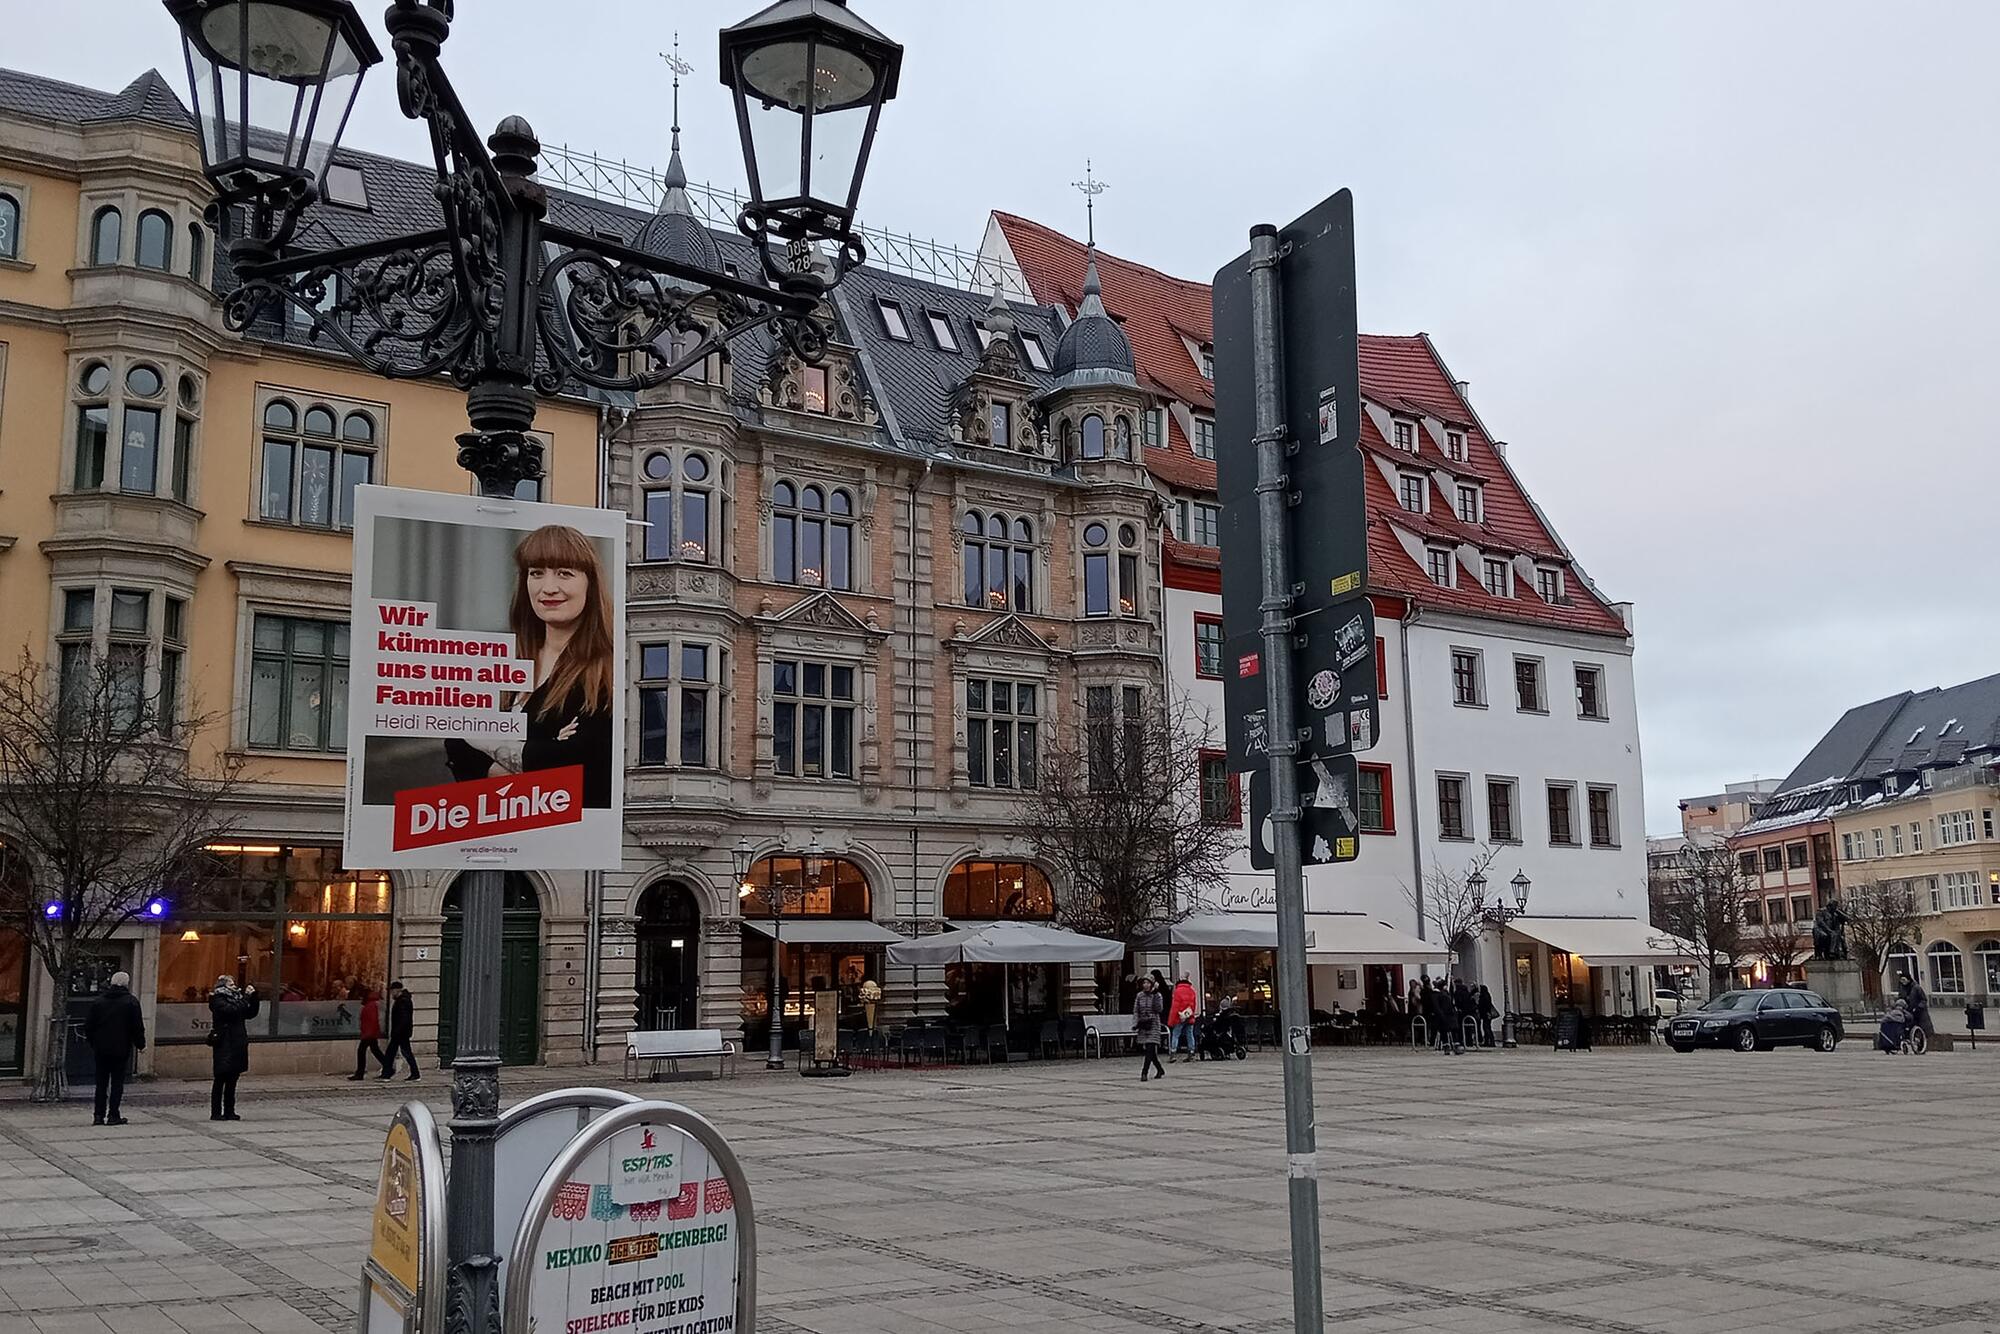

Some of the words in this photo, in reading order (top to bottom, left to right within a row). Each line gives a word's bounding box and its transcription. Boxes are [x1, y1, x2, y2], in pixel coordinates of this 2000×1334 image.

[378, 605, 429, 627] Wir
[378, 631, 508, 657] kümmern
[377, 662, 426, 680] uns
[431, 664, 473, 682] um
[477, 664, 526, 684] alle
[376, 685, 493, 709] Familien
[375, 714, 420, 730] Heidi
[425, 715, 520, 733] Reichinnek
[410, 798, 469, 835] Die
[477, 782, 570, 824] Linke
[622, 1154, 673, 1173] ESPITAS
[546, 1243, 601, 1270] MEXIKO
[658, 1223, 728, 1251] CKENBERG!
[590, 1282, 631, 1305] BEACH
[632, 1278, 654, 1297] MIT
[656, 1273, 685, 1292] POOL
[566, 1310, 630, 1334] SPIELECKE
[631, 1303, 654, 1324] FÜR
[657, 1300, 677, 1319] DIE
[677, 1295, 704, 1314] KIDS
